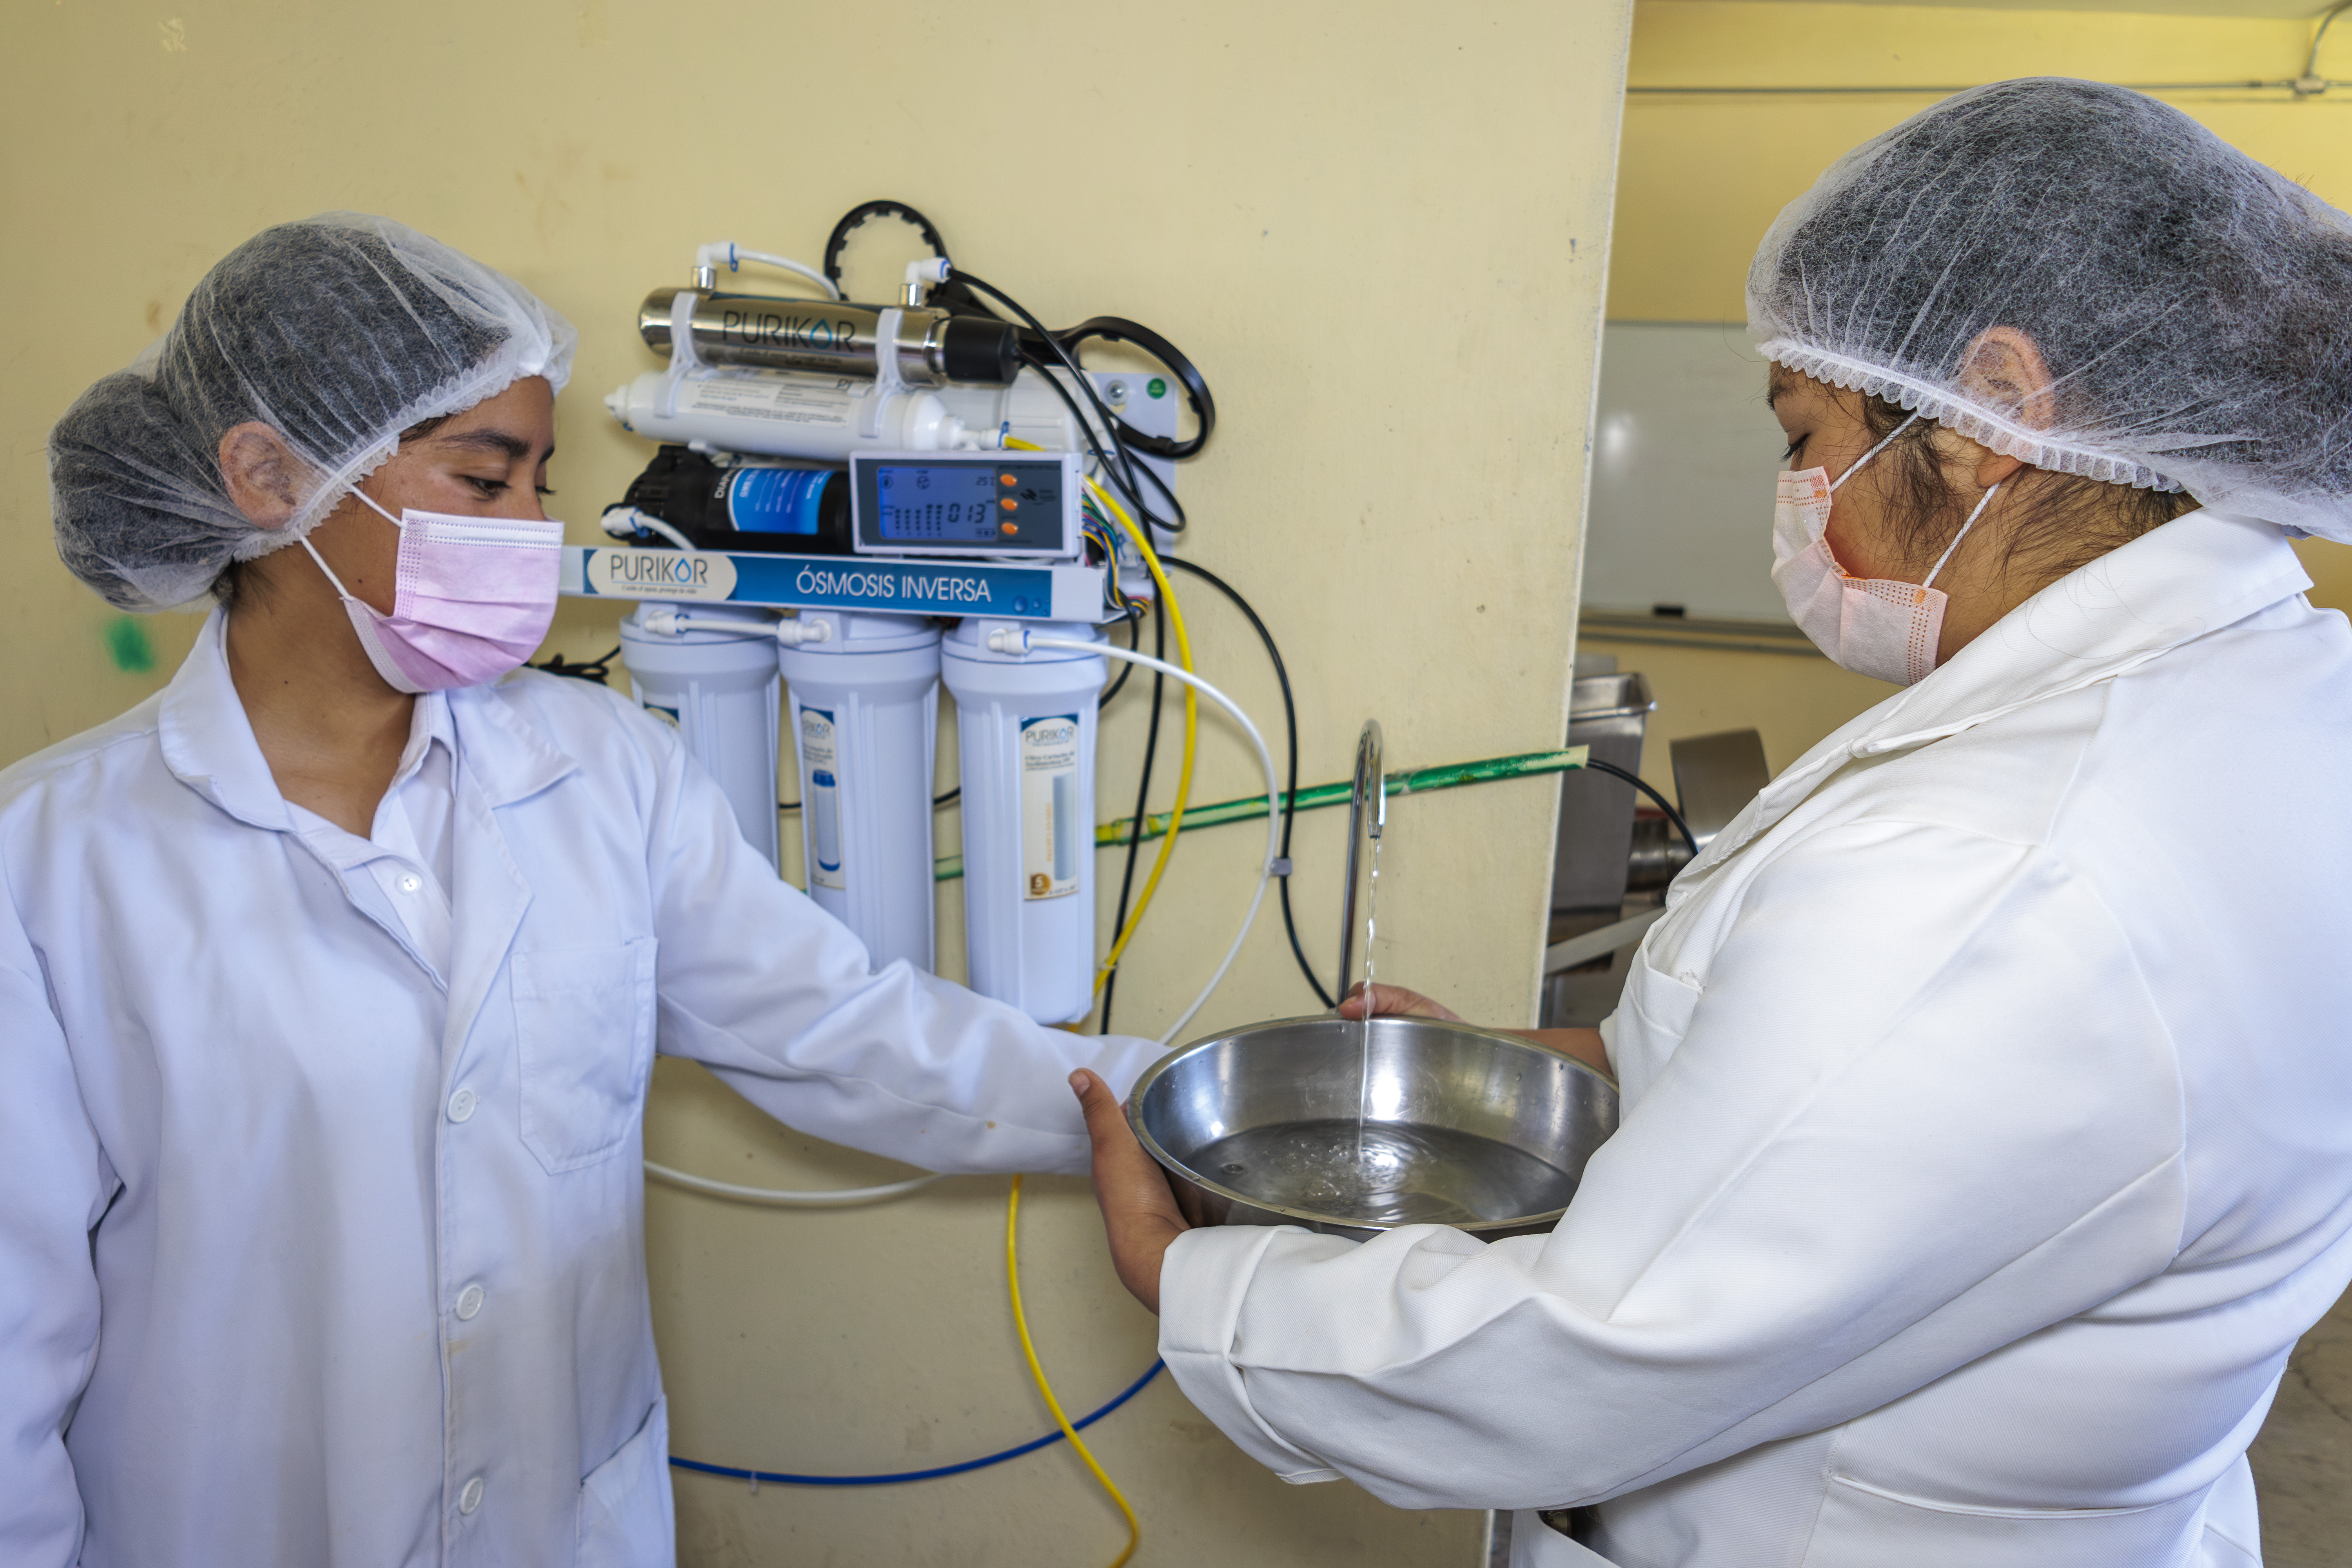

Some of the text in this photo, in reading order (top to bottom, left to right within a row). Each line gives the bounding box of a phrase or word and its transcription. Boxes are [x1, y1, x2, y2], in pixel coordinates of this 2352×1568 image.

[723, 310, 855, 352] PURIKOR
[947, 503, 987, 524] 013
[611, 554, 708, 584] PURIKOR
[796, 564, 992, 603] ÓSMOSIS INVERSA
[1025, 726, 1074, 743] PURIKOR
